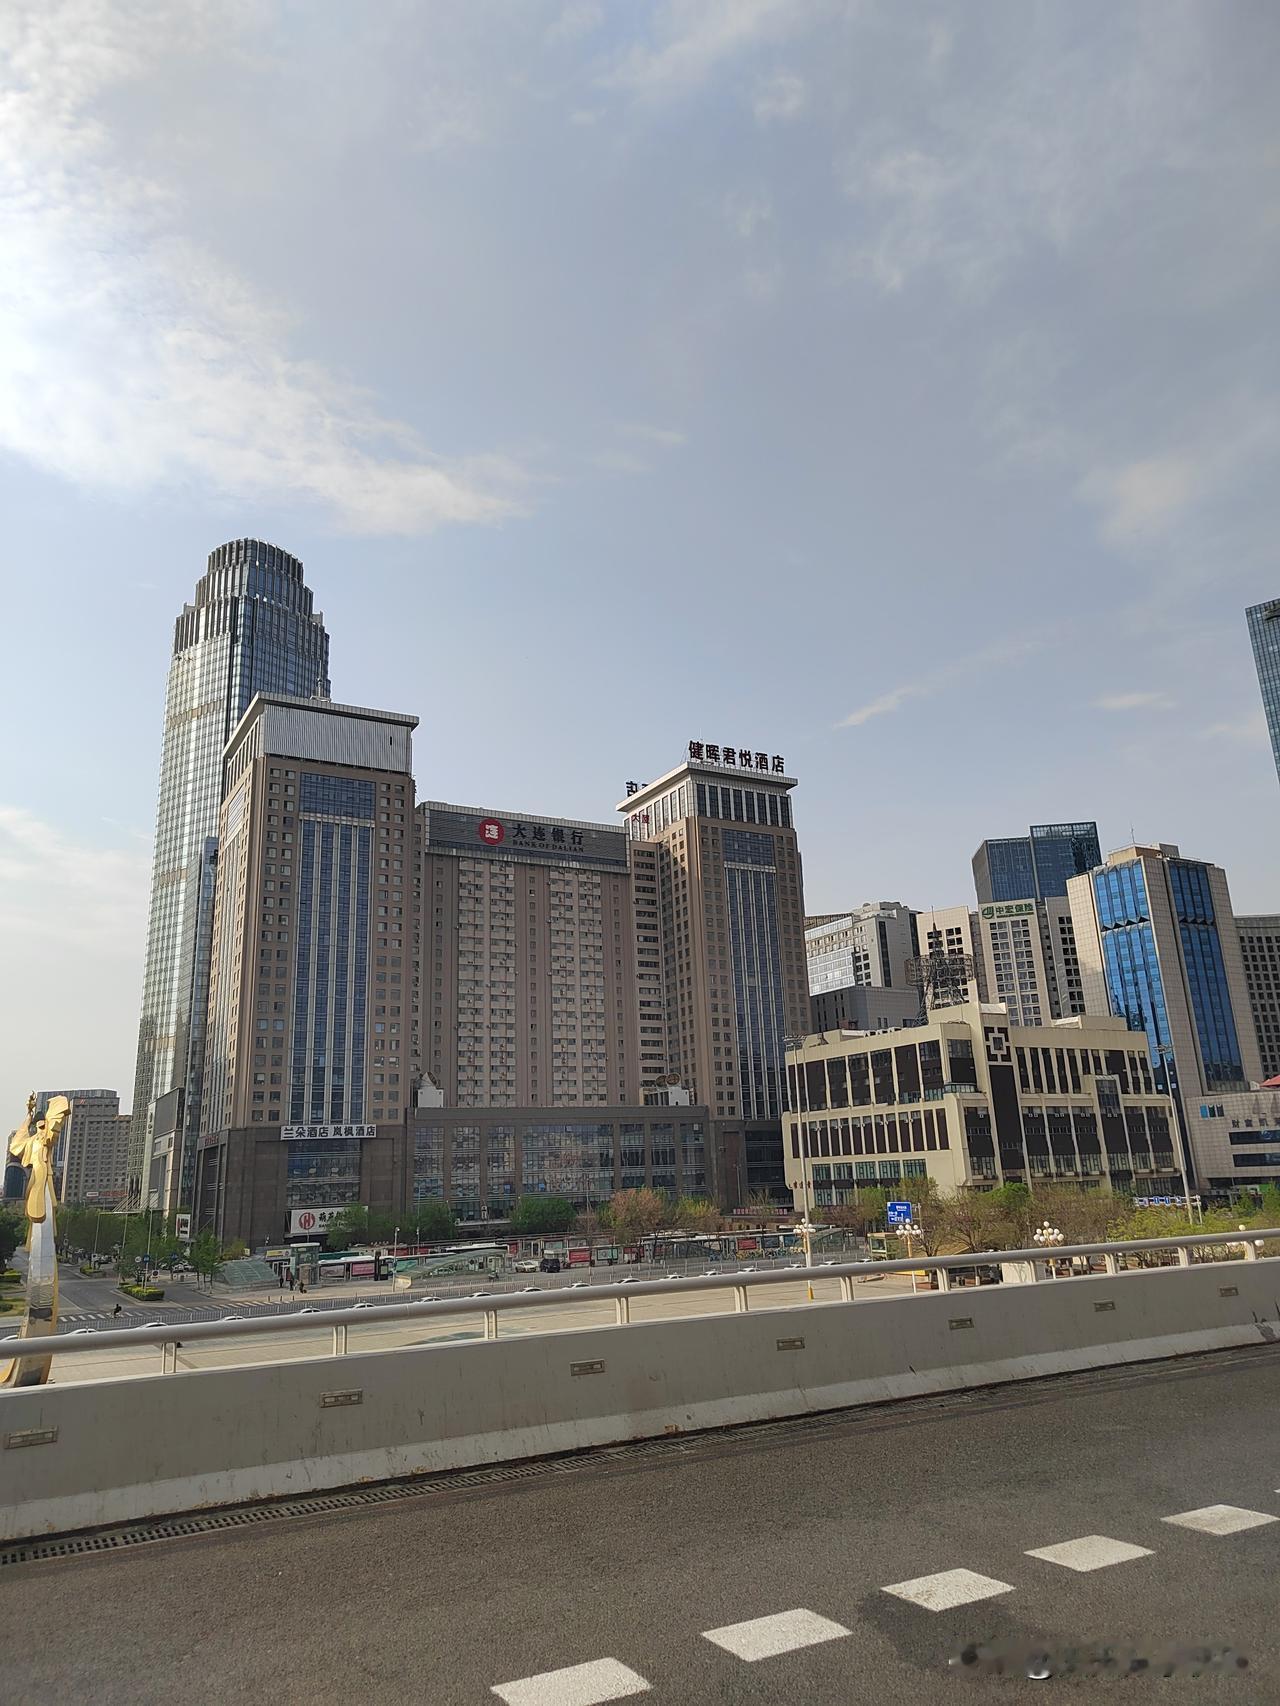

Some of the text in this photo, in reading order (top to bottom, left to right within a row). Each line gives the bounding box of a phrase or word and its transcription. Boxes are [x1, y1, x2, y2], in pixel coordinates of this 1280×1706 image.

[688, 740, 785, 773] 健晖君悦酒店
[512, 823, 584, 845] 大连银行
[512, 839, 536, 848] BANK
[552, 844, 584, 852] DALIAN
[283, 1126, 329, 1138] 兰朵酒店
